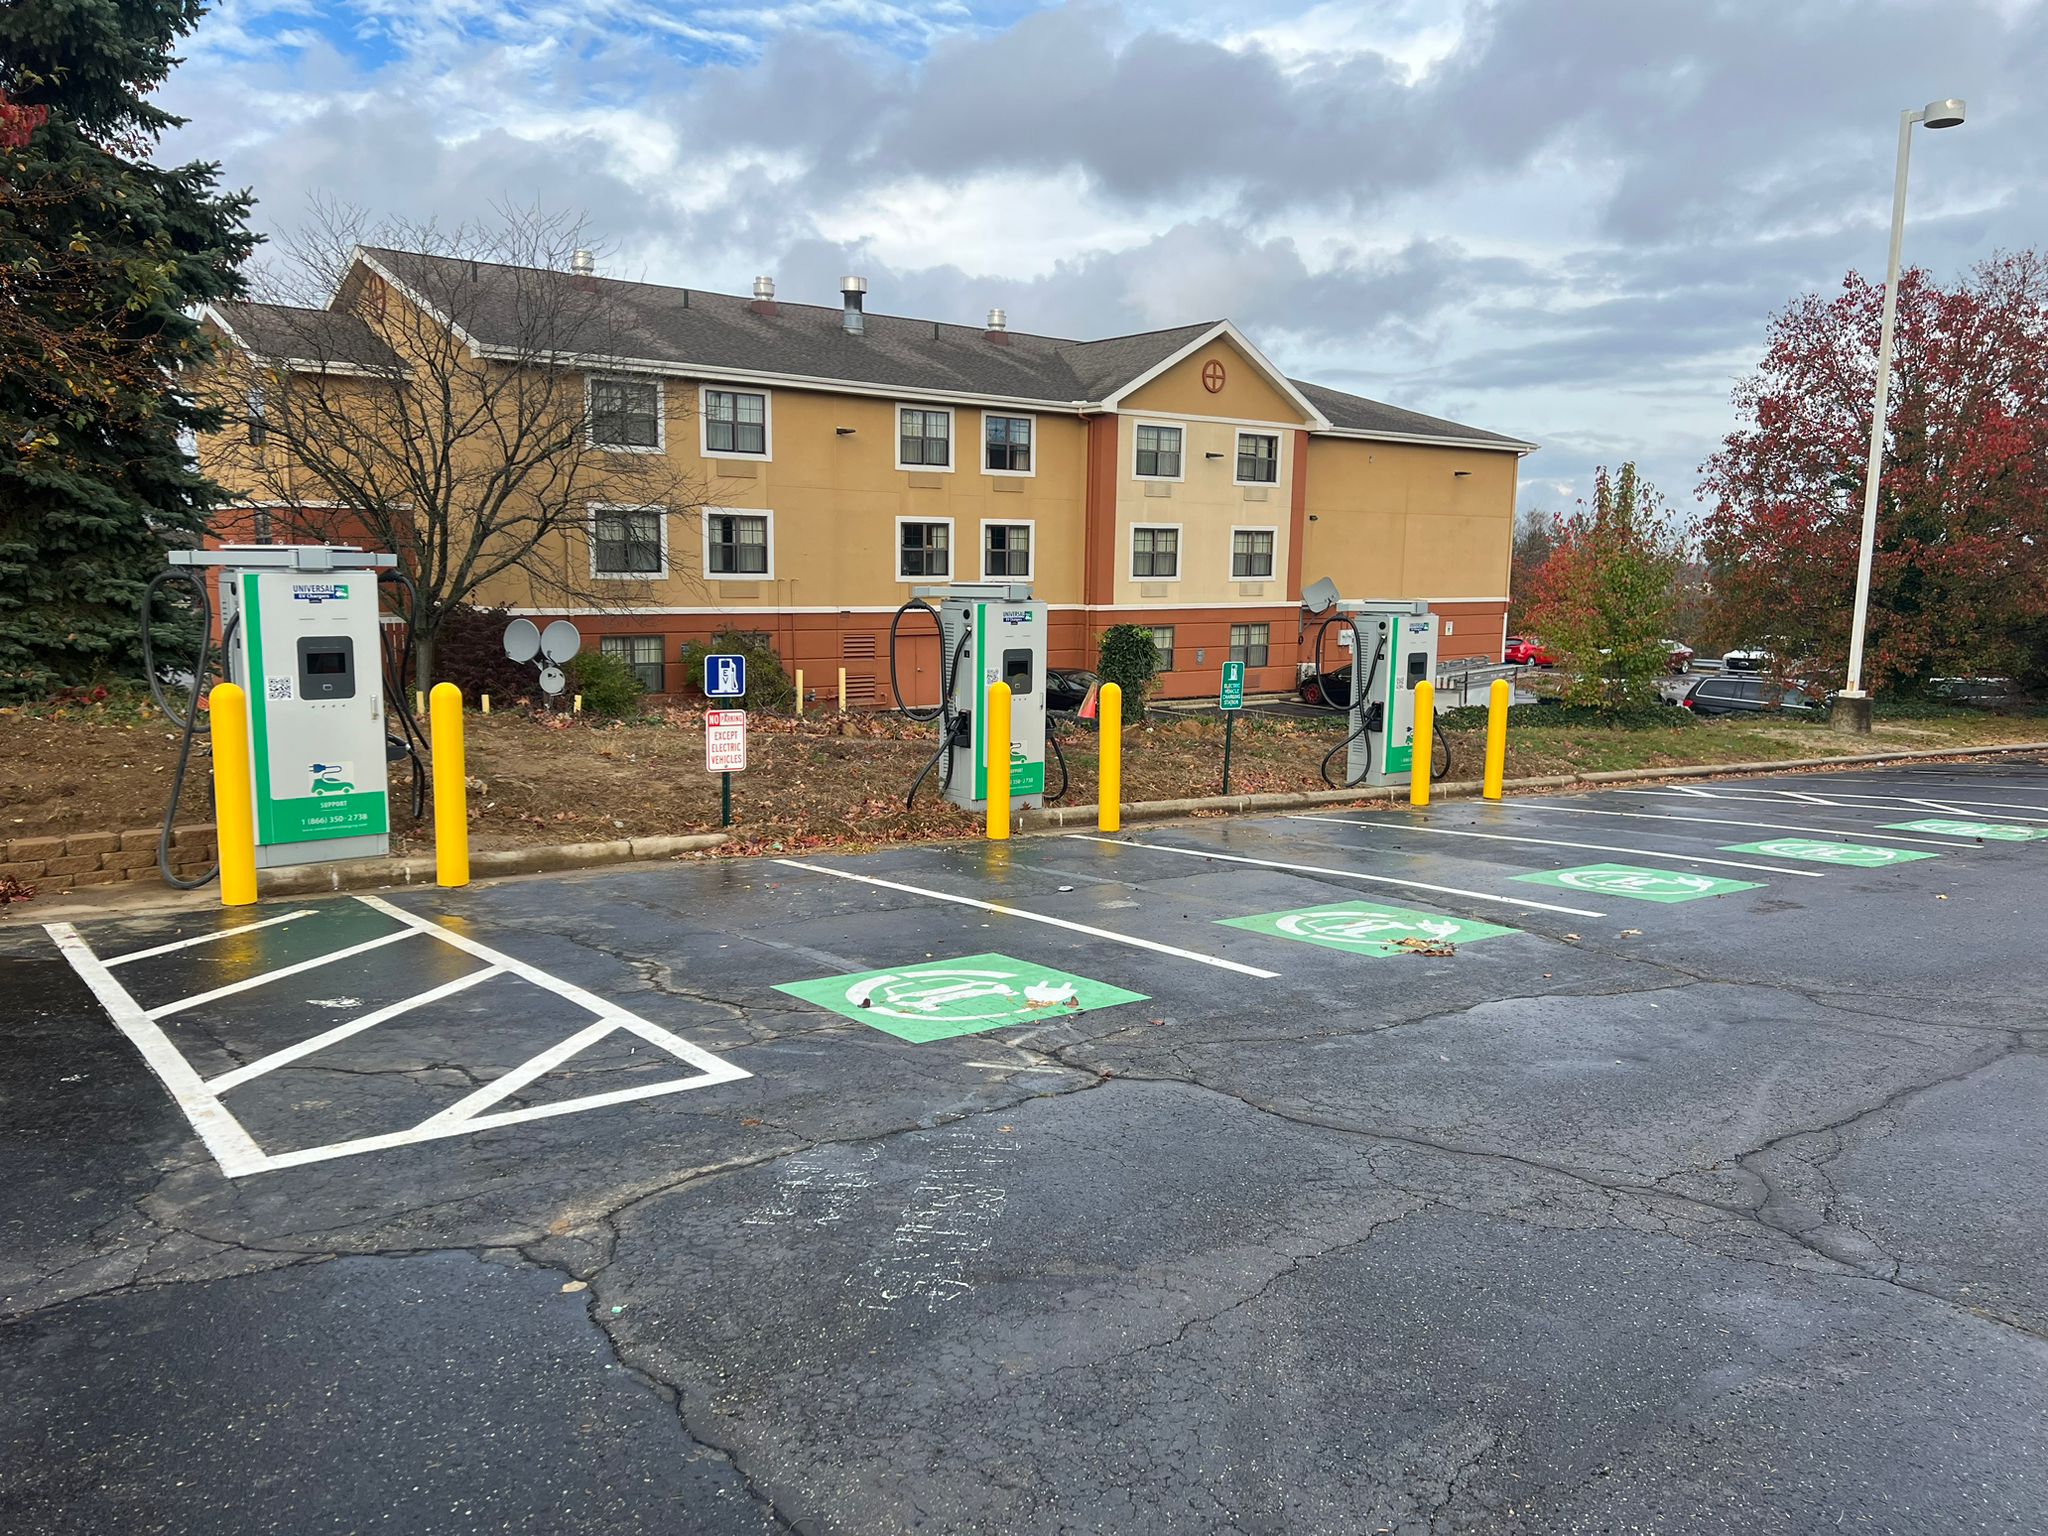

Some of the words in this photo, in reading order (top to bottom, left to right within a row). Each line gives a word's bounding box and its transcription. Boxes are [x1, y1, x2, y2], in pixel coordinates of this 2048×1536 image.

[293, 584, 334, 592] UNIVERSAL
[709, 714, 719, 725] NO
[714, 731, 738, 740] EXCEPT
[712, 743, 741, 752] ELECTRIC
[711, 755, 742, 764] VEHICLES
[320, 800, 348, 808] SUPPORT
